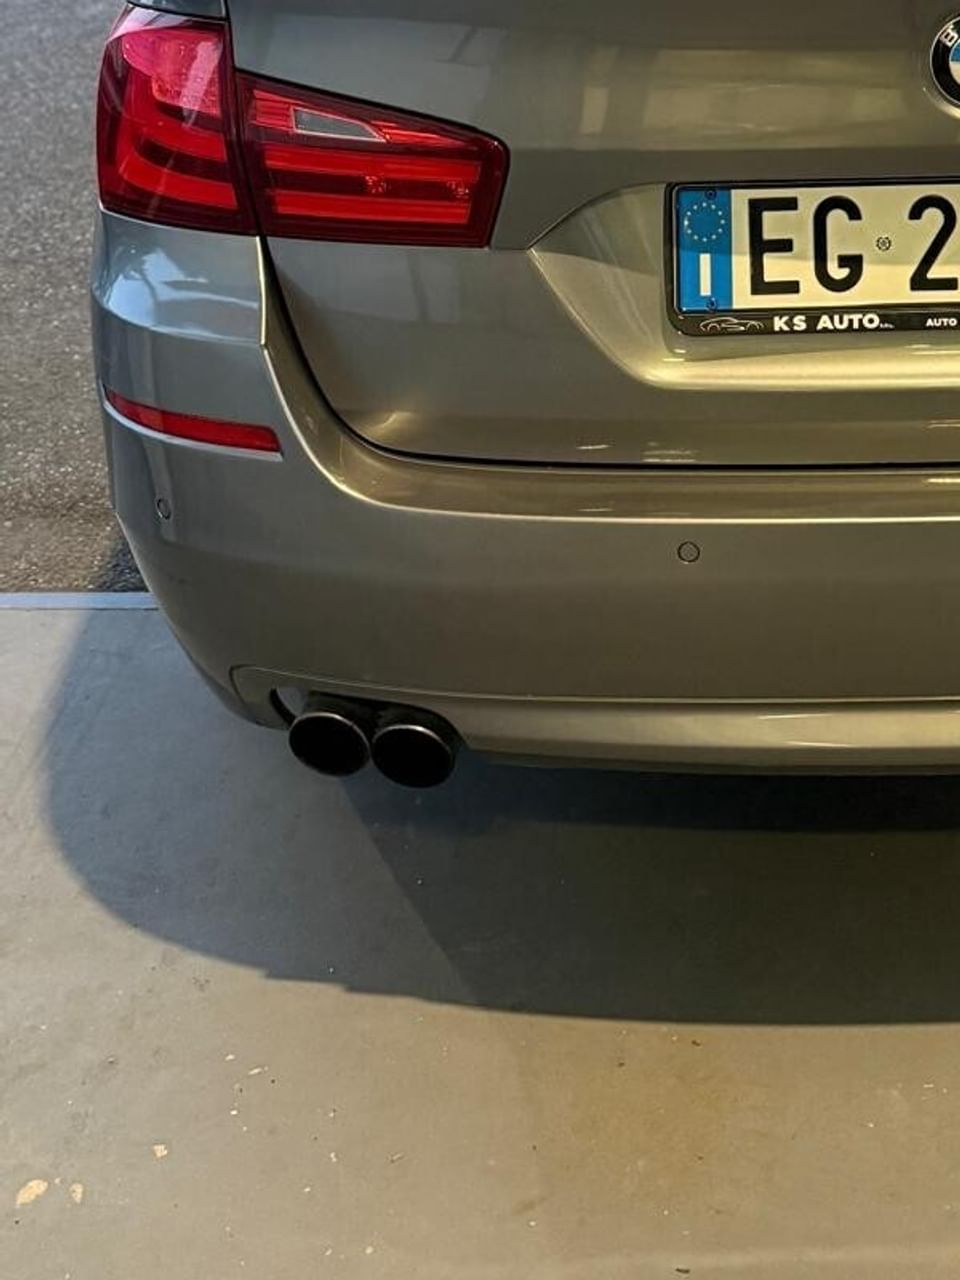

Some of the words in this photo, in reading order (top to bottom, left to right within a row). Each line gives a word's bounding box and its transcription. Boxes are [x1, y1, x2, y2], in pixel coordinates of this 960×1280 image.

[748, 195, 864, 296] EG
[816, 313, 879, 330] AUTO
[926, 318, 957, 327] AUTO
